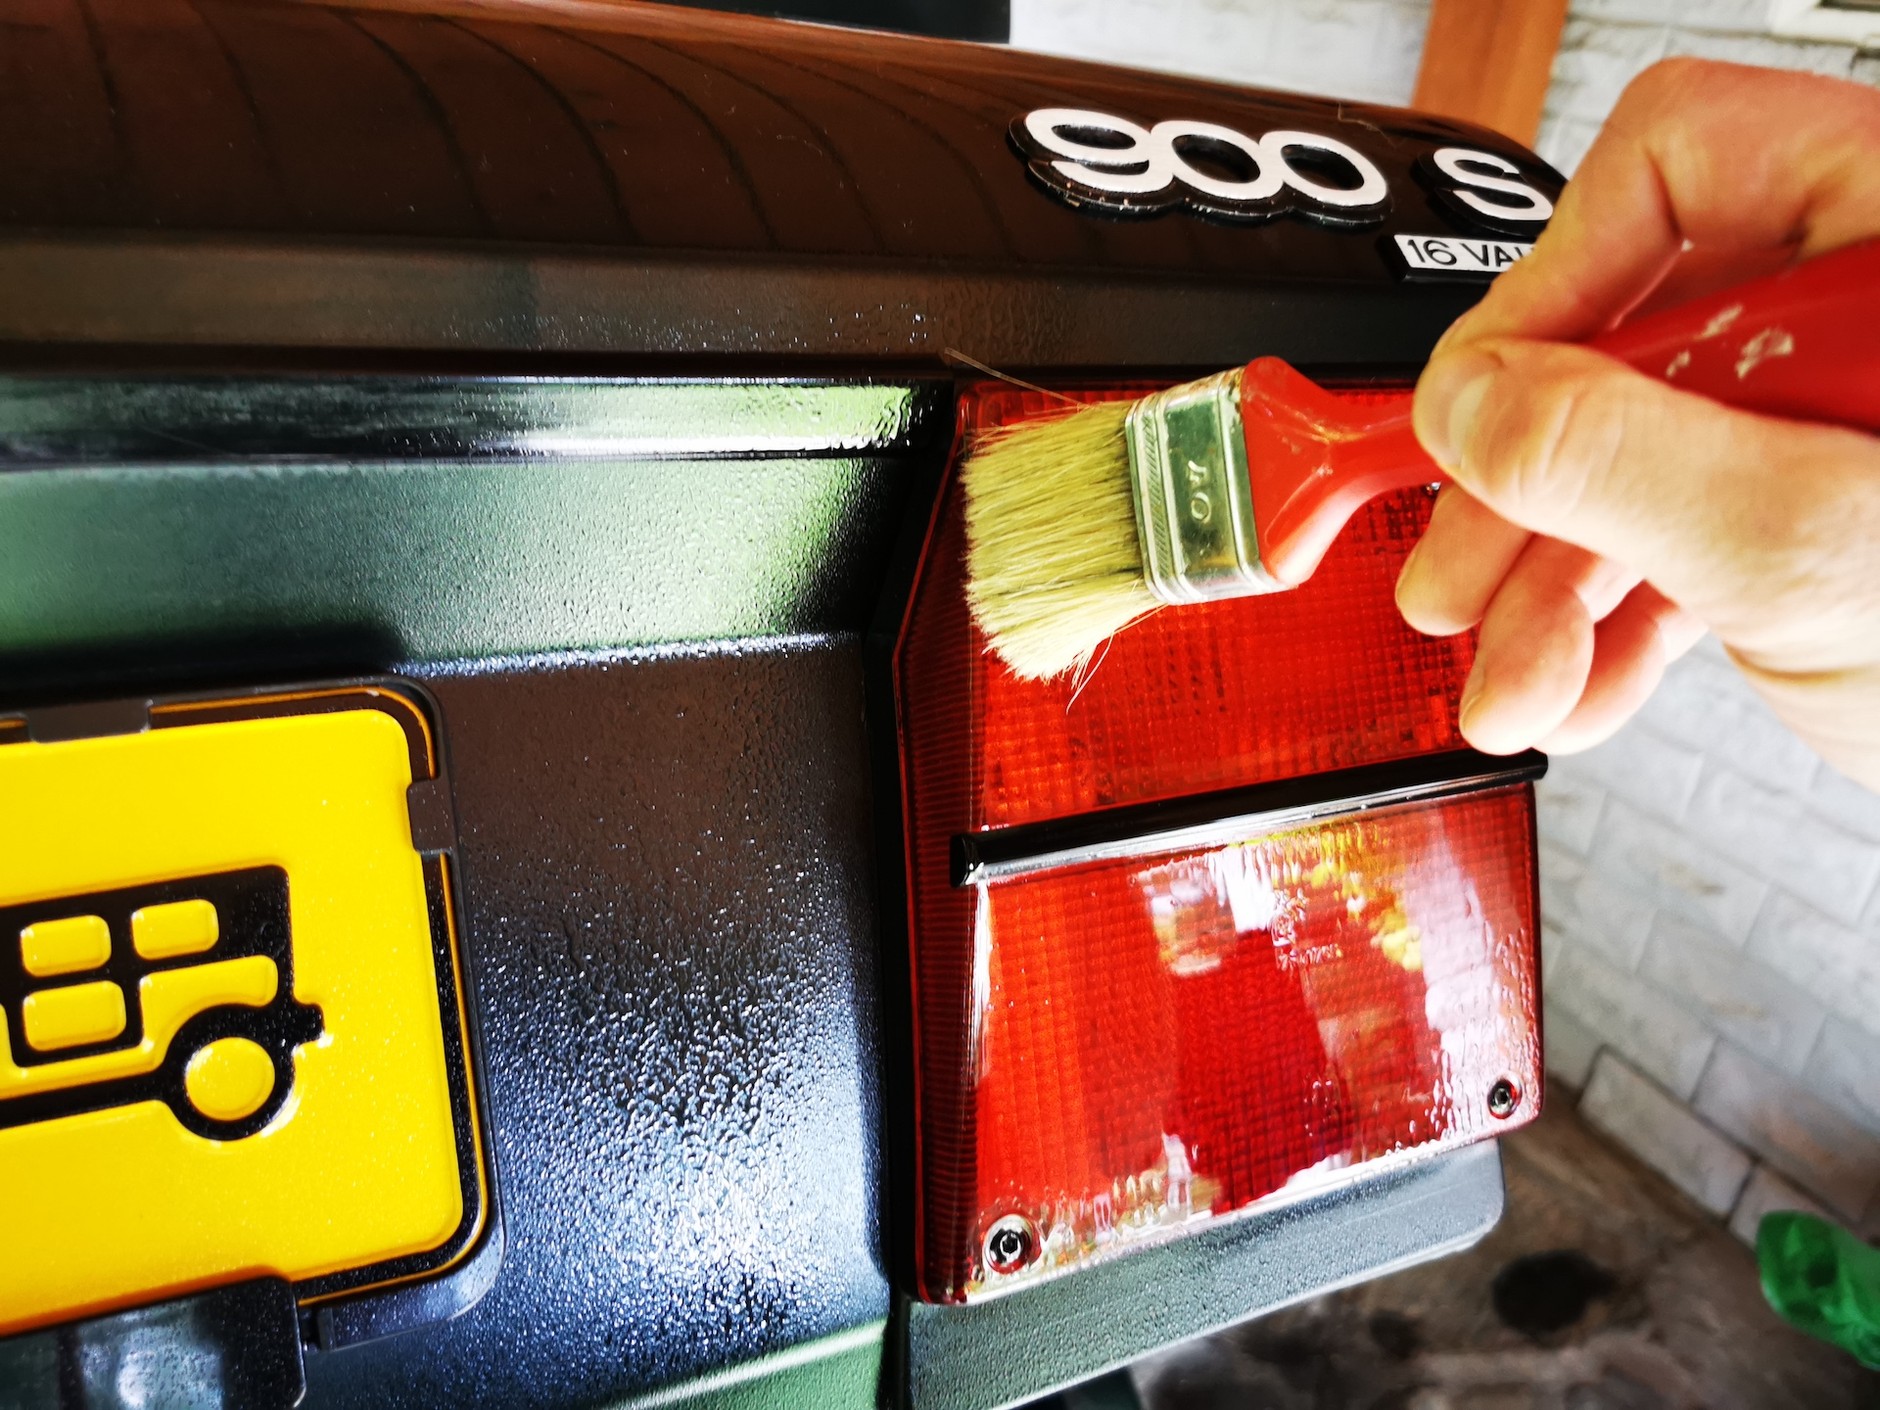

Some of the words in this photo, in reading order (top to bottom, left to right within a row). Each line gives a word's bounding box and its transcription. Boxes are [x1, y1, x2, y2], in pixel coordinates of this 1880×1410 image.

[1025, 108, 1388, 207] 900
[1433, 147, 1553, 221] S
[1407, 239, 1458, 266] 16
